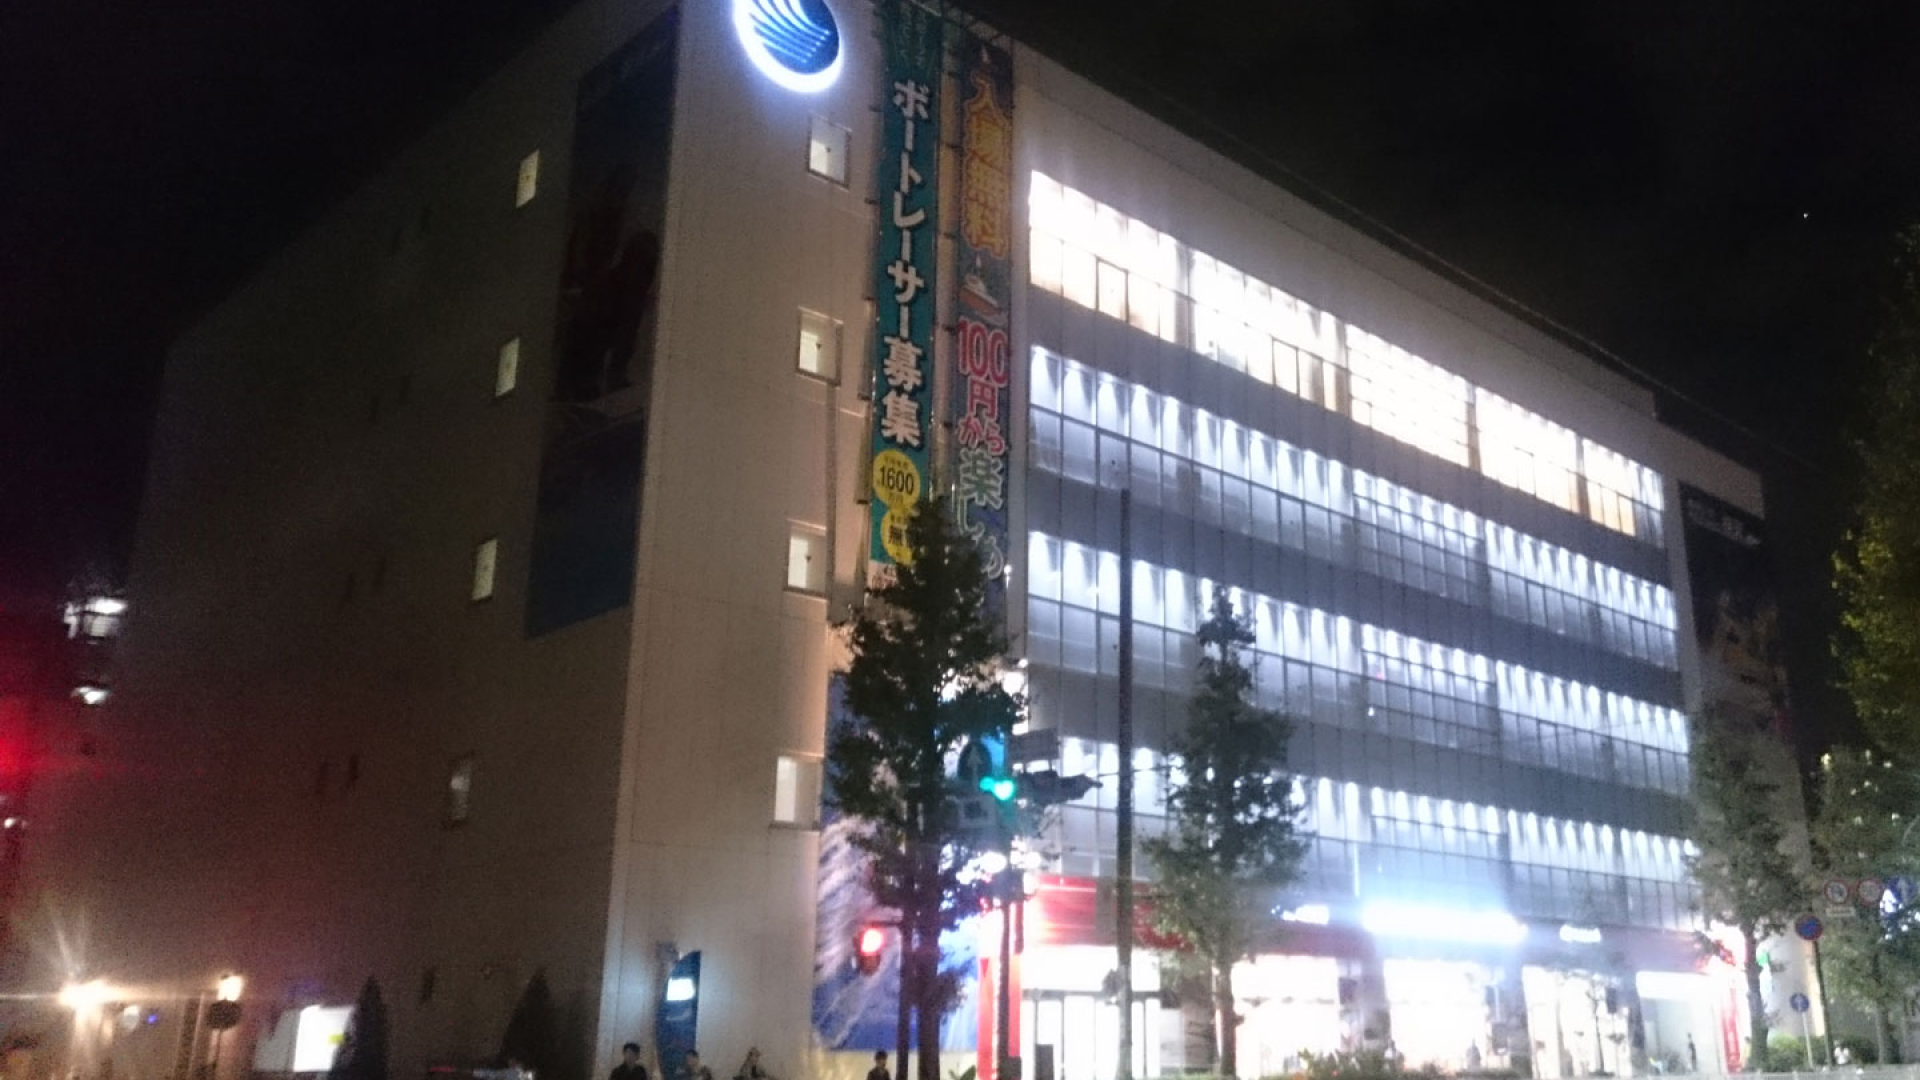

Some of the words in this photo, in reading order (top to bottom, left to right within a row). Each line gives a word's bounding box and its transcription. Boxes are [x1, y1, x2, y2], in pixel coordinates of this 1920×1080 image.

[880, 79, 929, 447] ボートレーサー募集
[880, 465, 914, 496] 1600
